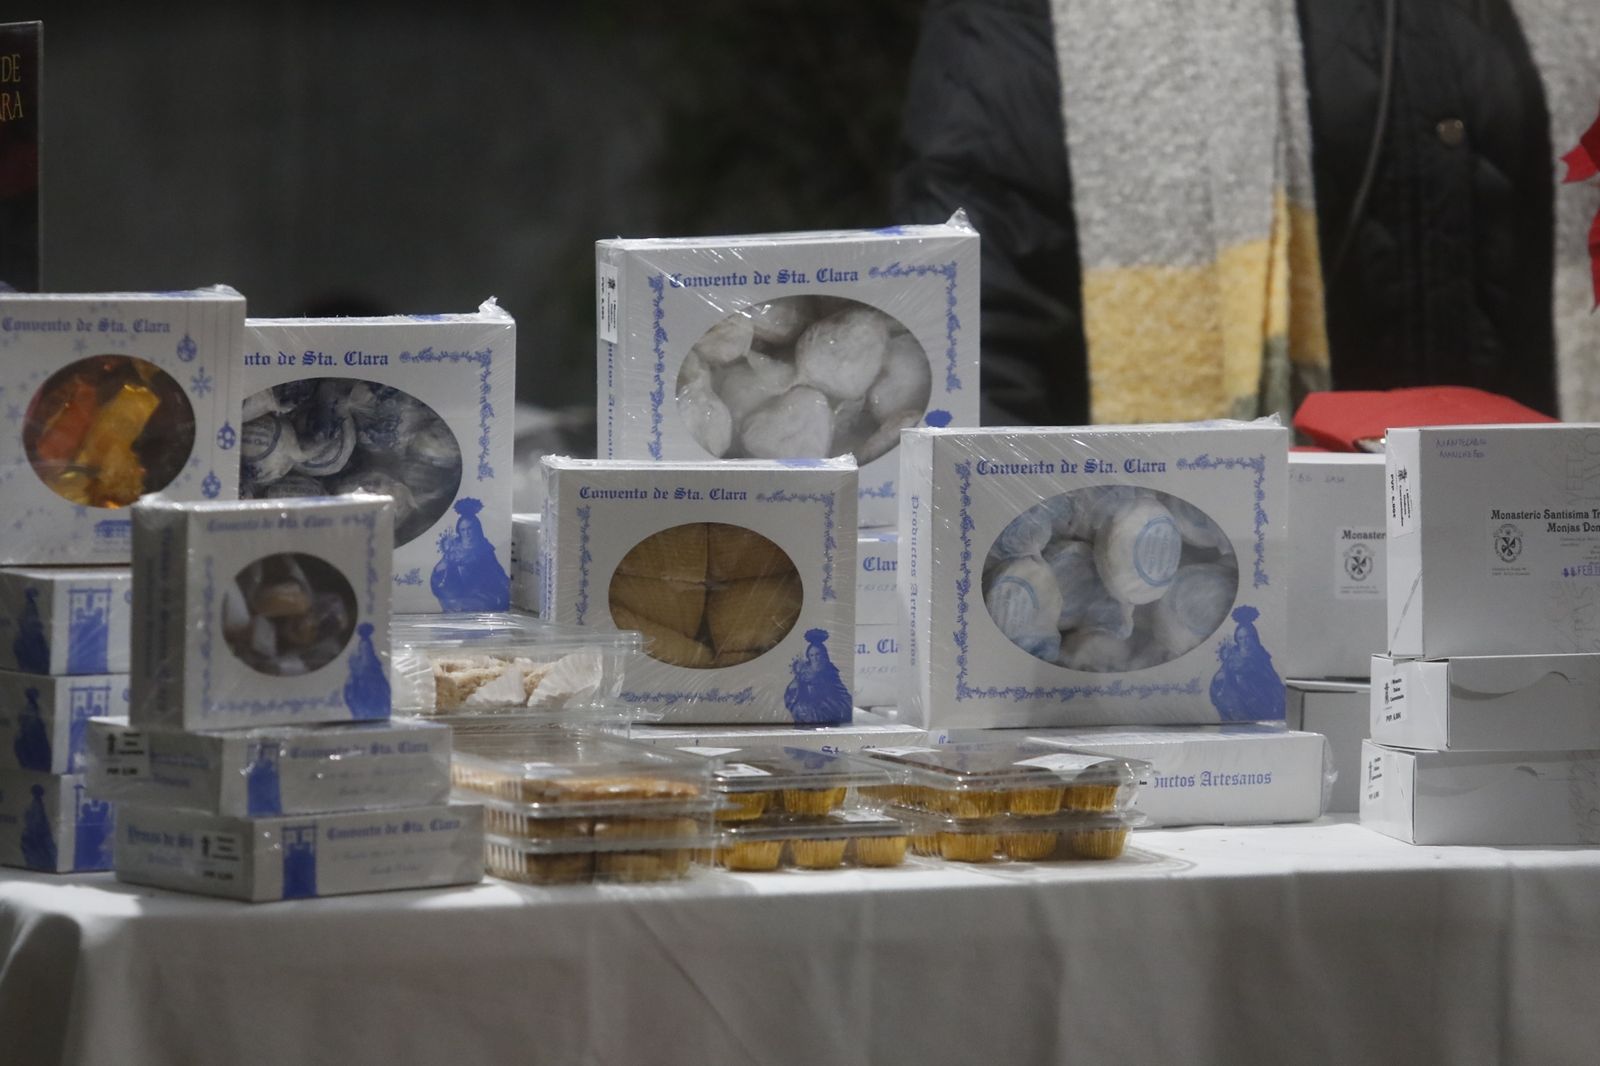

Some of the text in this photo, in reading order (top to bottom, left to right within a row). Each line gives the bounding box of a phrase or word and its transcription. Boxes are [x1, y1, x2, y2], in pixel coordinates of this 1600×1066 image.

[1, 53, 21, 83] DE
[0, 90, 24, 122] RA
[668, 268, 859, 289] Convento de Sta. Clara
[2, 316, 71, 333] Convento
[76, 317, 93, 333] de
[132, 318, 171, 334] Clara
[243, 350, 389, 366] nto de Sta. Clara
[976, 458, 1167, 476] Convento de Sta. Clara
[579, 486, 747, 501] Convento de Sta. Clara
[1491, 509, 1541, 520] Monasterio
[1341, 529, 1387, 541] Monaster
[1546, 522, 1580, 535] Monjas
[863, 556, 898, 572] Clar
[1200, 769, 1272, 787] Artesanos
